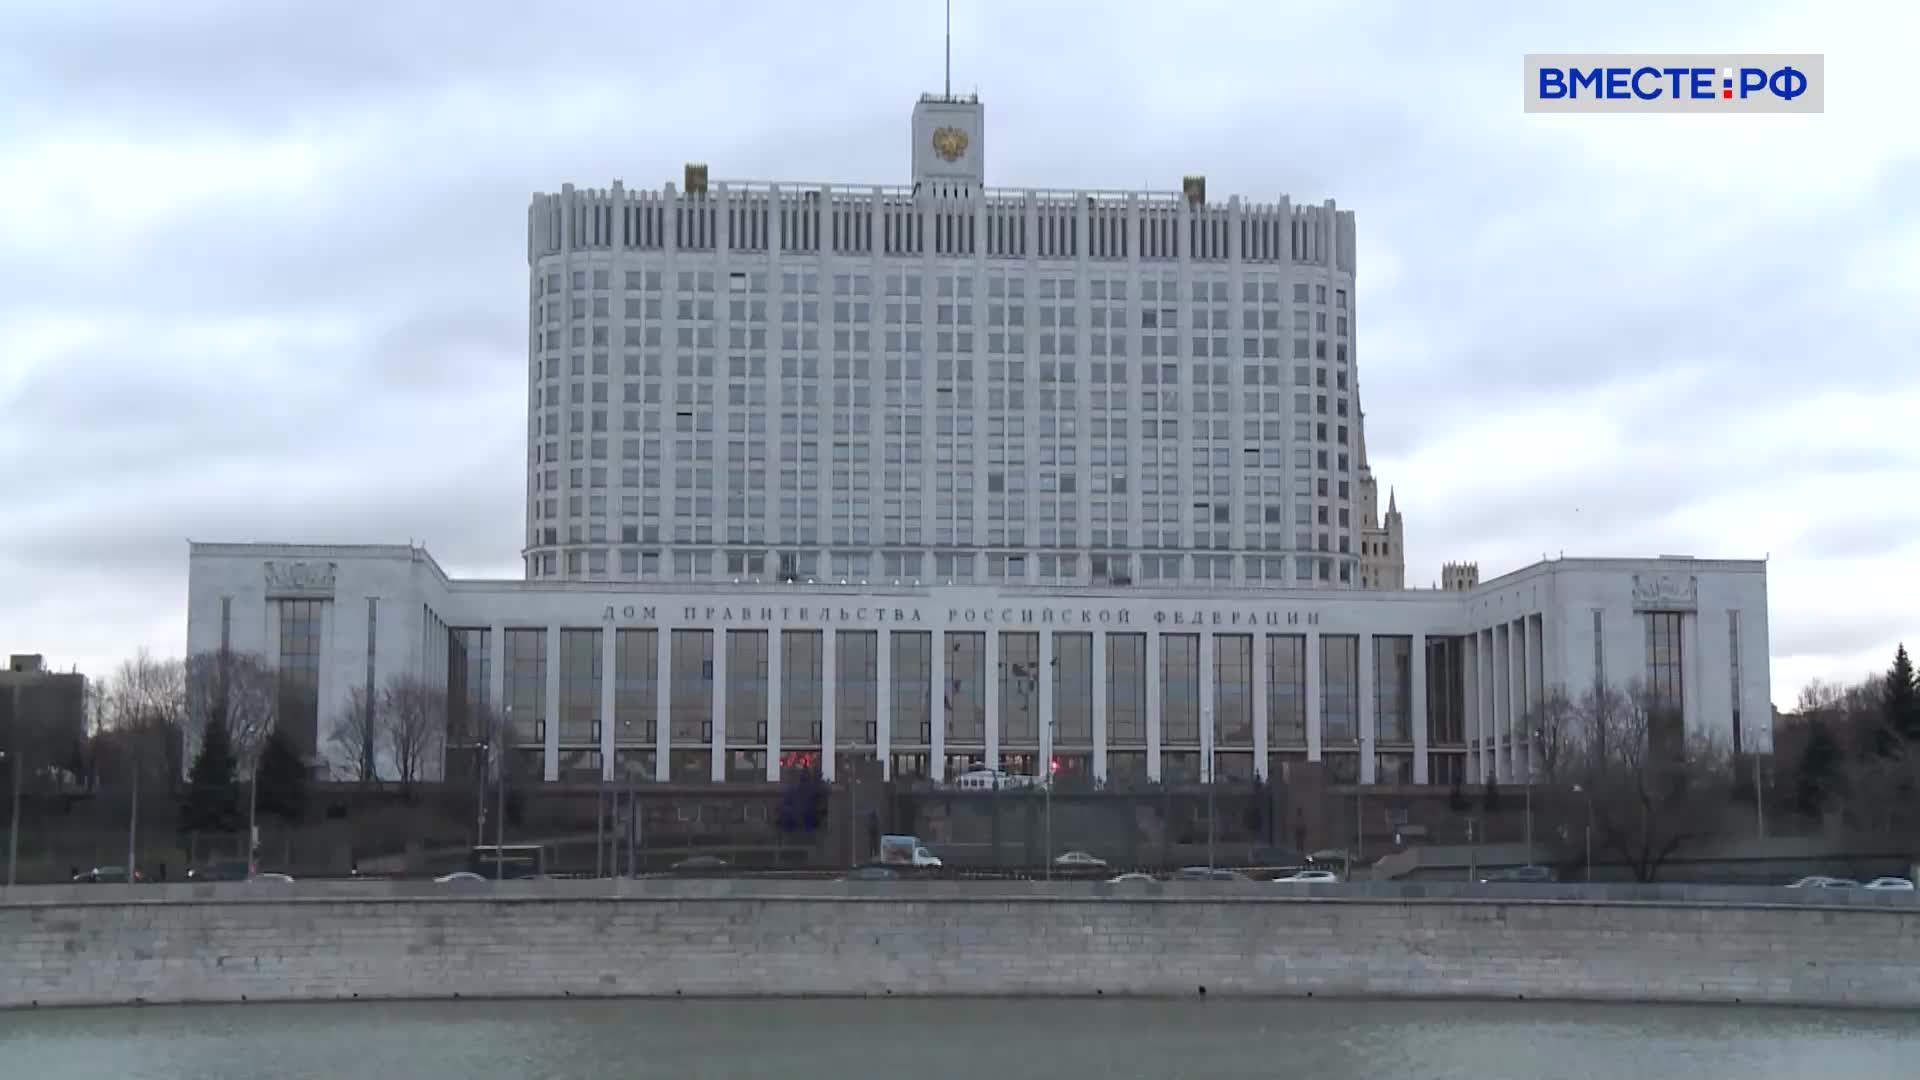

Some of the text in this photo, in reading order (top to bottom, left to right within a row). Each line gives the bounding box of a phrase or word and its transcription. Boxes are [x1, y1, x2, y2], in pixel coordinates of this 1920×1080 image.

[602, 606, 1320, 625] ДОМ ПРАВИТЕЛЬСТВА РОССИЙСКОЙ ФЕДЕРАЦИИ
